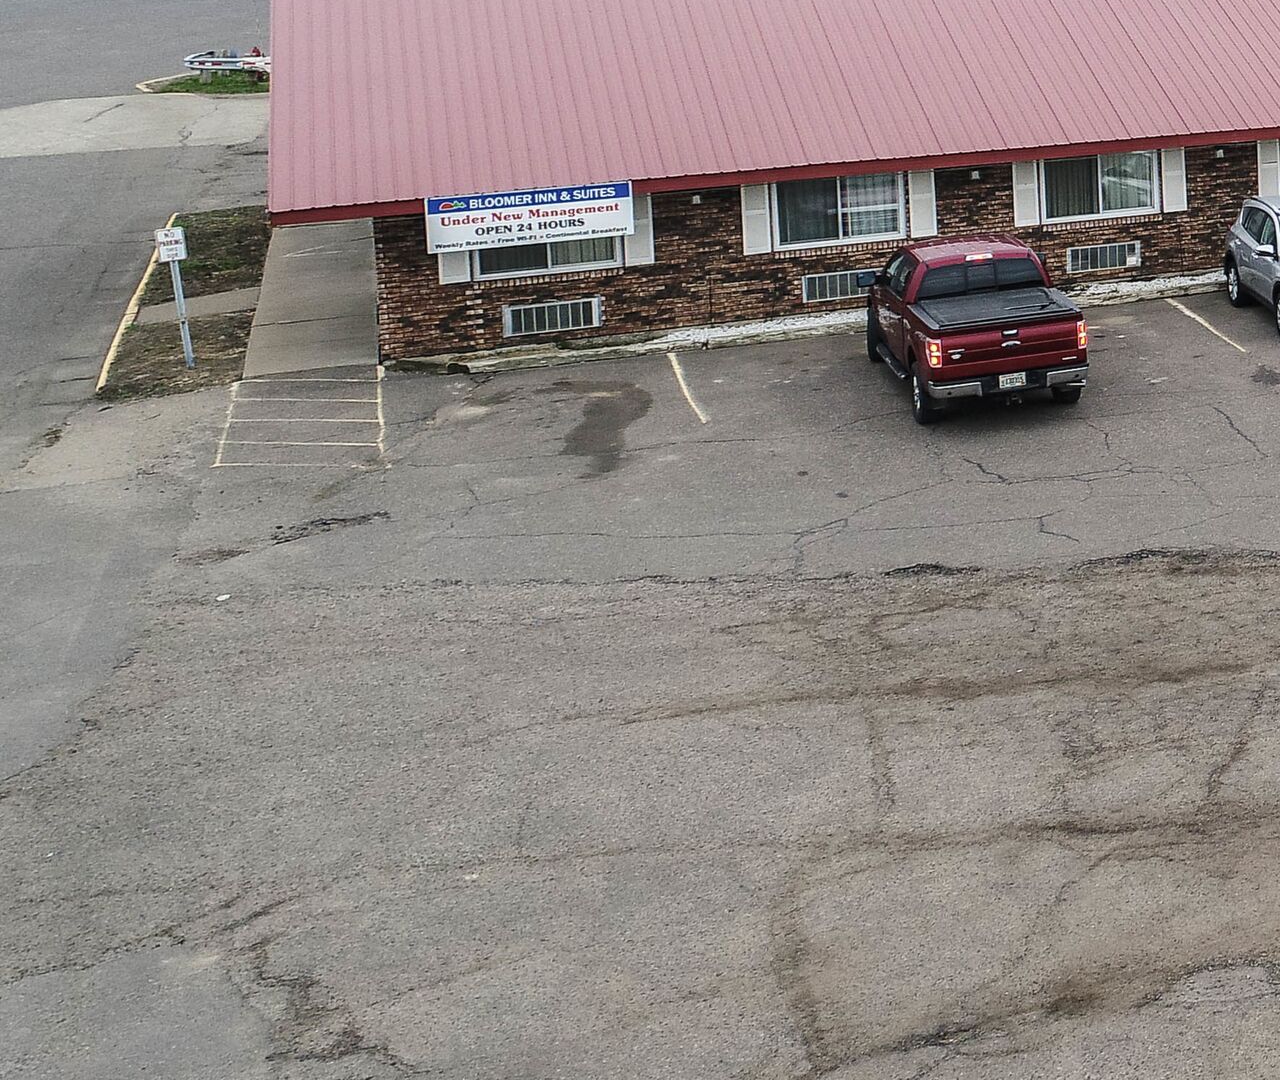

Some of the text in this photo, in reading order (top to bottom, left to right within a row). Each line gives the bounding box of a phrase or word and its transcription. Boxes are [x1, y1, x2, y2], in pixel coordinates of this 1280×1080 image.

[469, 187, 616, 209] BLOOMER INN & SUITES
[440, 202, 620, 227] Under New Management
[435, 241, 463, 249] Weekly
[466, 239, 488, 247] Rates
[545, 230, 589, 239] Continental
[591, 226, 627, 235] Breakfast
[474, 218, 585, 236] OPEN 24 HOURS
